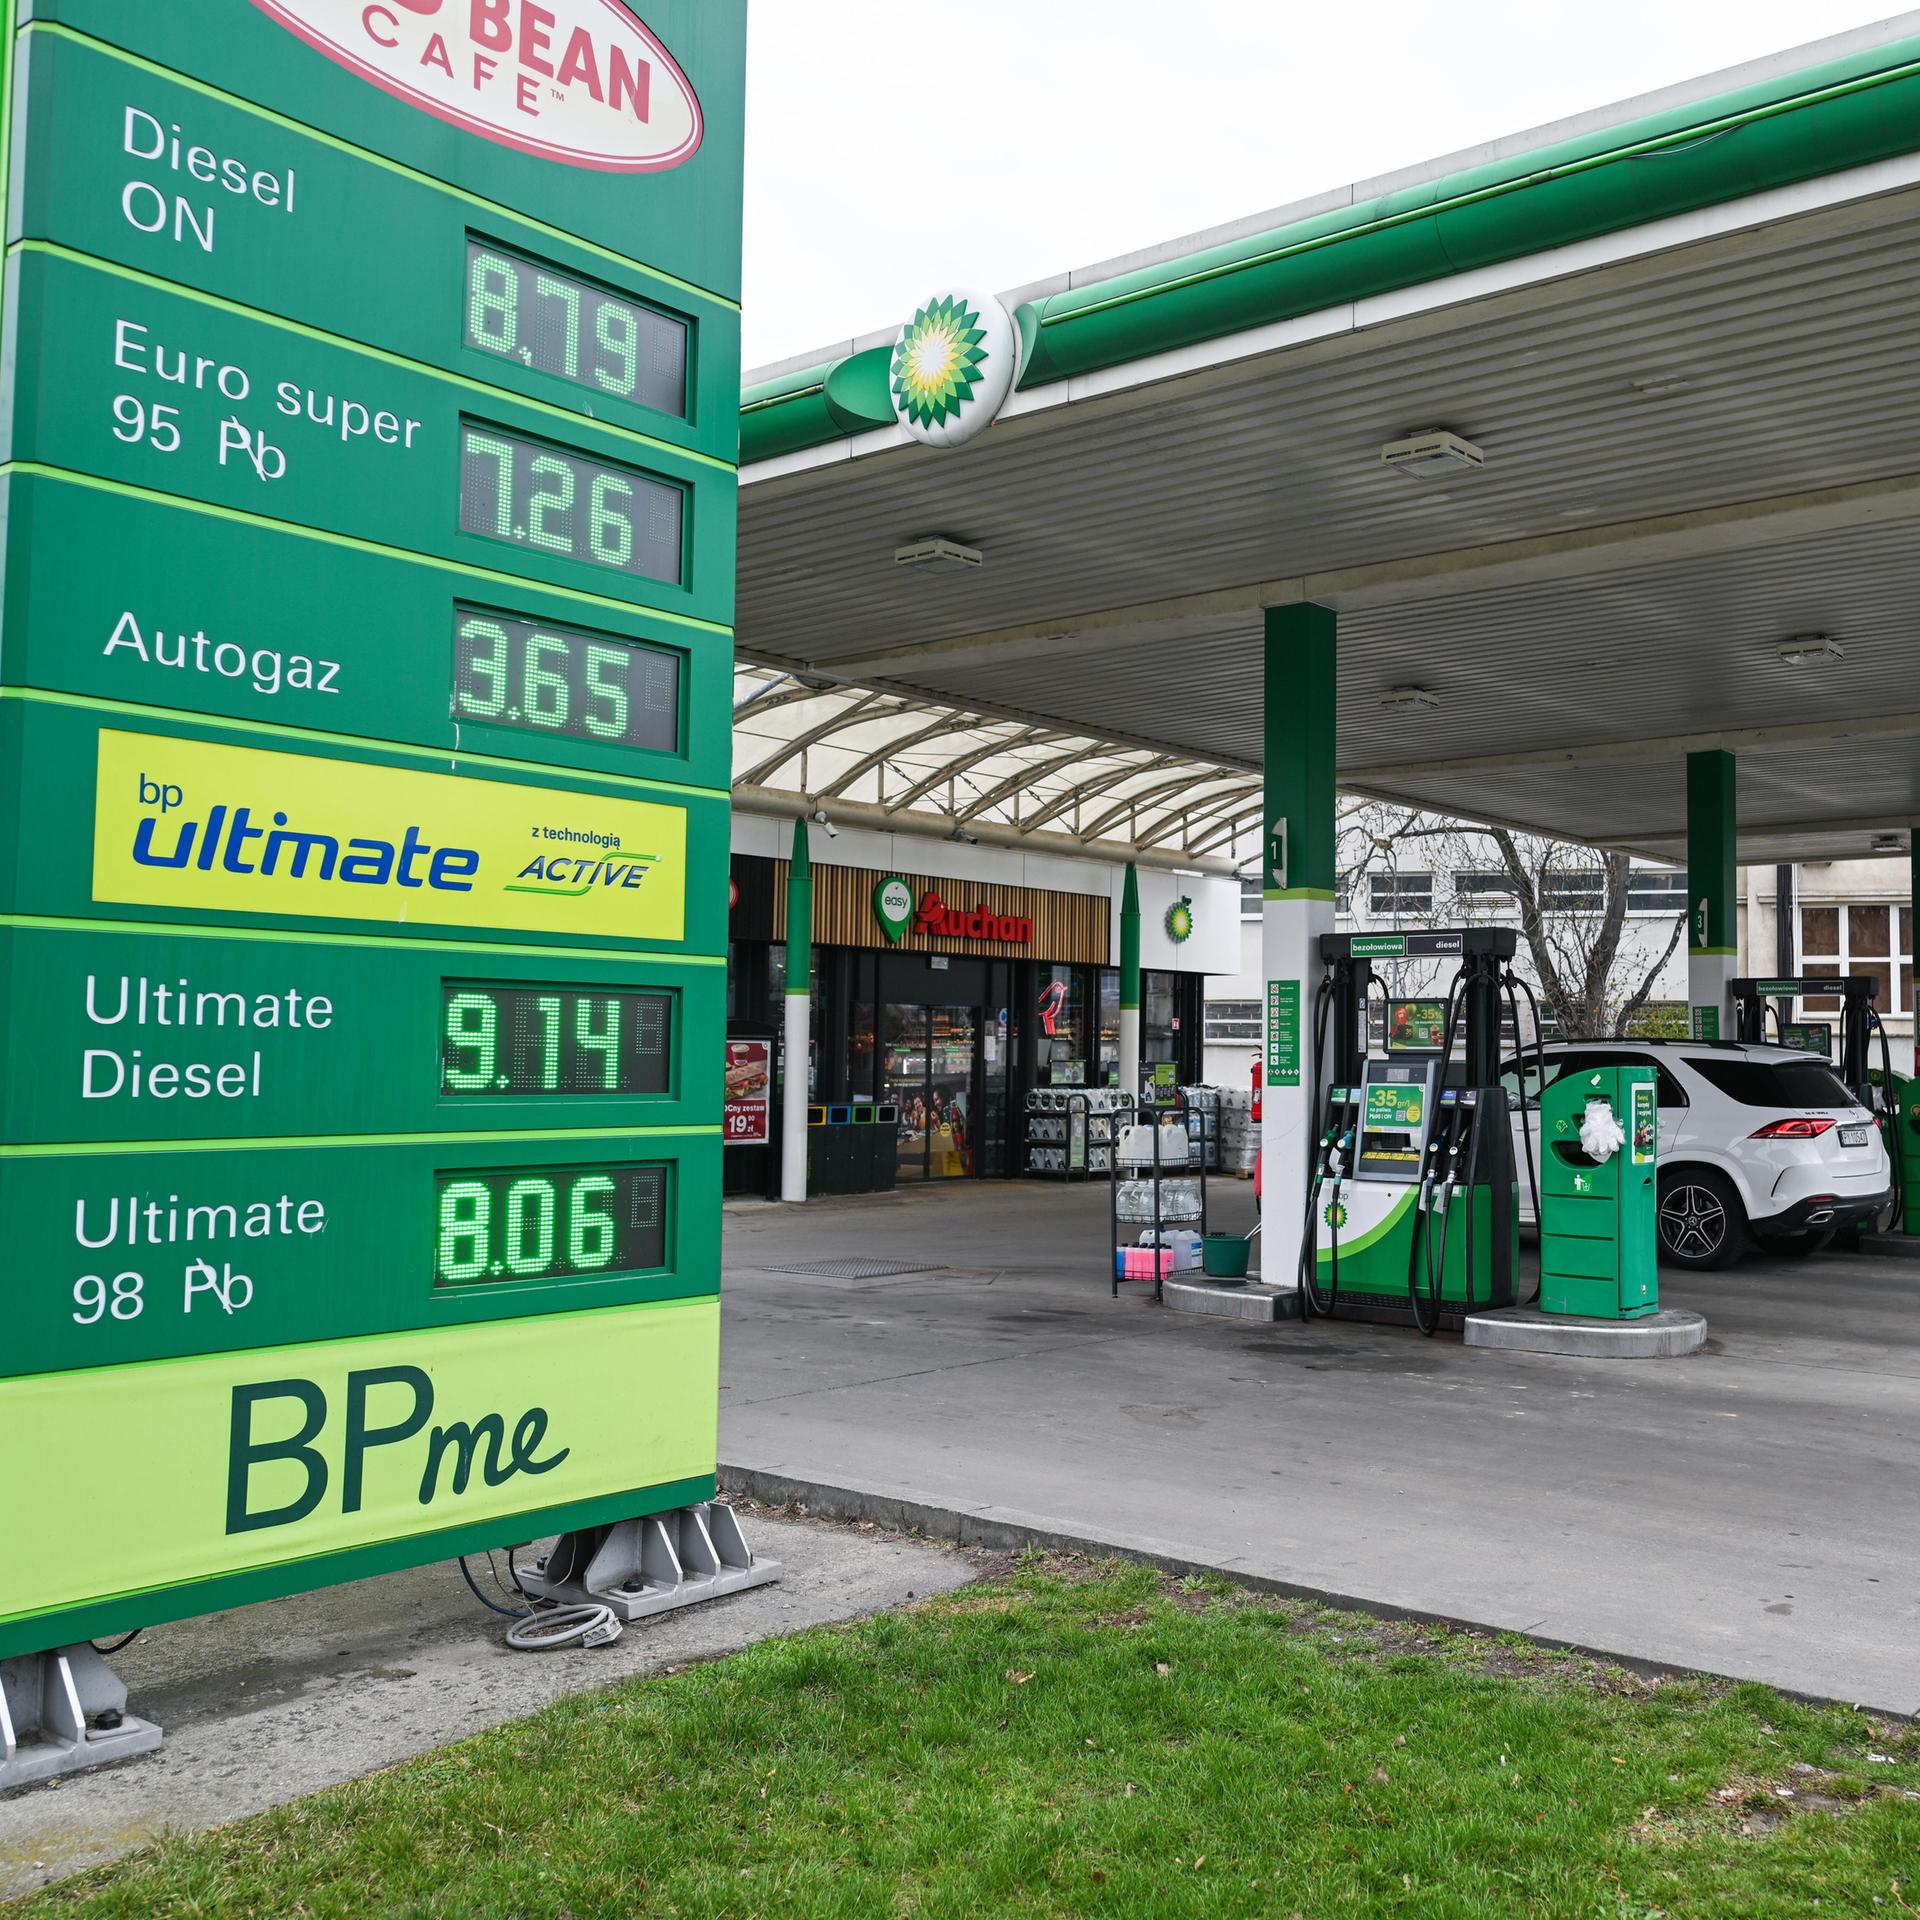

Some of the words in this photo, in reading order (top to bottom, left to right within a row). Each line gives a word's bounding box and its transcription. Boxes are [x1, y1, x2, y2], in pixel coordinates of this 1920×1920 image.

[362, 4, 541, 117] CAFE
[469, 0, 650, 125] BEAN
[123, 105, 296, 213] Diesel
[123, 181, 214, 252] ON
[471, 254, 638, 397] 8.79
[114, 319, 250, 400] Euro
[276, 380, 422, 448] super
[113, 395, 180, 452] 95
[466, 434, 633, 566] 7.26
[104, 612, 340, 694] Autogaz
[458, 619, 630, 739] 3.65
[139, 773, 184, 811] bp
[133, 805, 480, 893] ultimate
[531, 826, 540, 838] z
[543, 826, 621, 850] technologią
[1271, 841, 1277, 860] 1
[516, 855, 649, 889] ACTIVE
[884, 895, 908, 909] easy
[914, 892, 1033, 943] Auchan
[1697, 915, 1703, 929] 3
[1352, 942, 1403, 951] bezołowiowa
[1435, 940, 1460, 948] diesel
[86, 975, 333, 1029] Ultimate
[445, 994, 620, 1091] 9.14
[82, 1049, 261, 1098] Diesel
[729, 1115, 747, 1133] 19
[743, 1104, 765, 1112] zestaw
[75, 1195, 325, 1249] Ultimate
[439, 1176, 616, 1280] 8.06
[72, 1271, 144, 1324] 98
